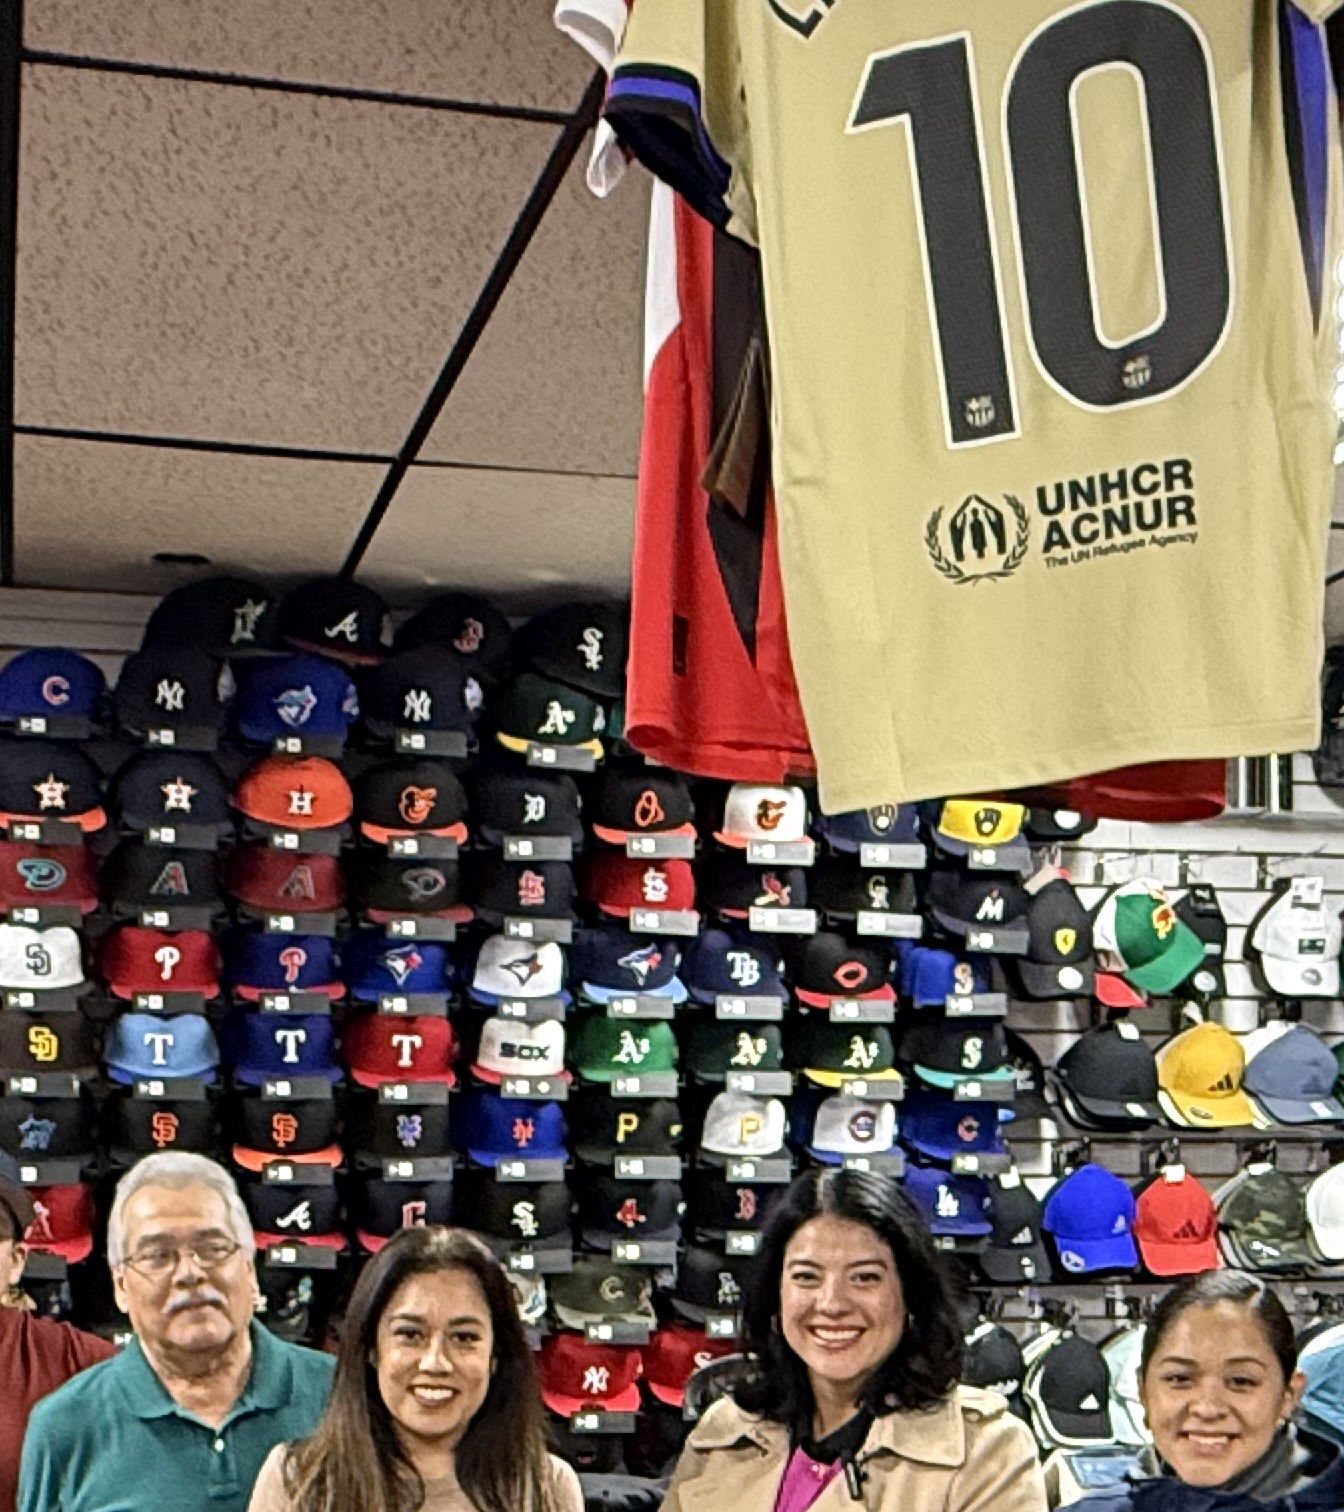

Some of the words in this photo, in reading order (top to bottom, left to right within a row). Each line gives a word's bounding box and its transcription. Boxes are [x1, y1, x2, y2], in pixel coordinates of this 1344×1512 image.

[846, 0, 1236, 449] 10
[1035, 458, 1194, 517] UNHCR
[1041, 494, 1198, 554] ACNUR
[1044, 556, 1068, 569] The
[1070, 550, 1091, 564] UN
[1093, 538, 1146, 557] Refugee
[1148, 531, 1199, 549] Agency
[155, 946, 181, 980] P
[143, 1032, 174, 1065] T
[275, 1029, 306, 1063] T
[392, 1034, 422, 1068] T
[616, 1112, 640, 1143] P
